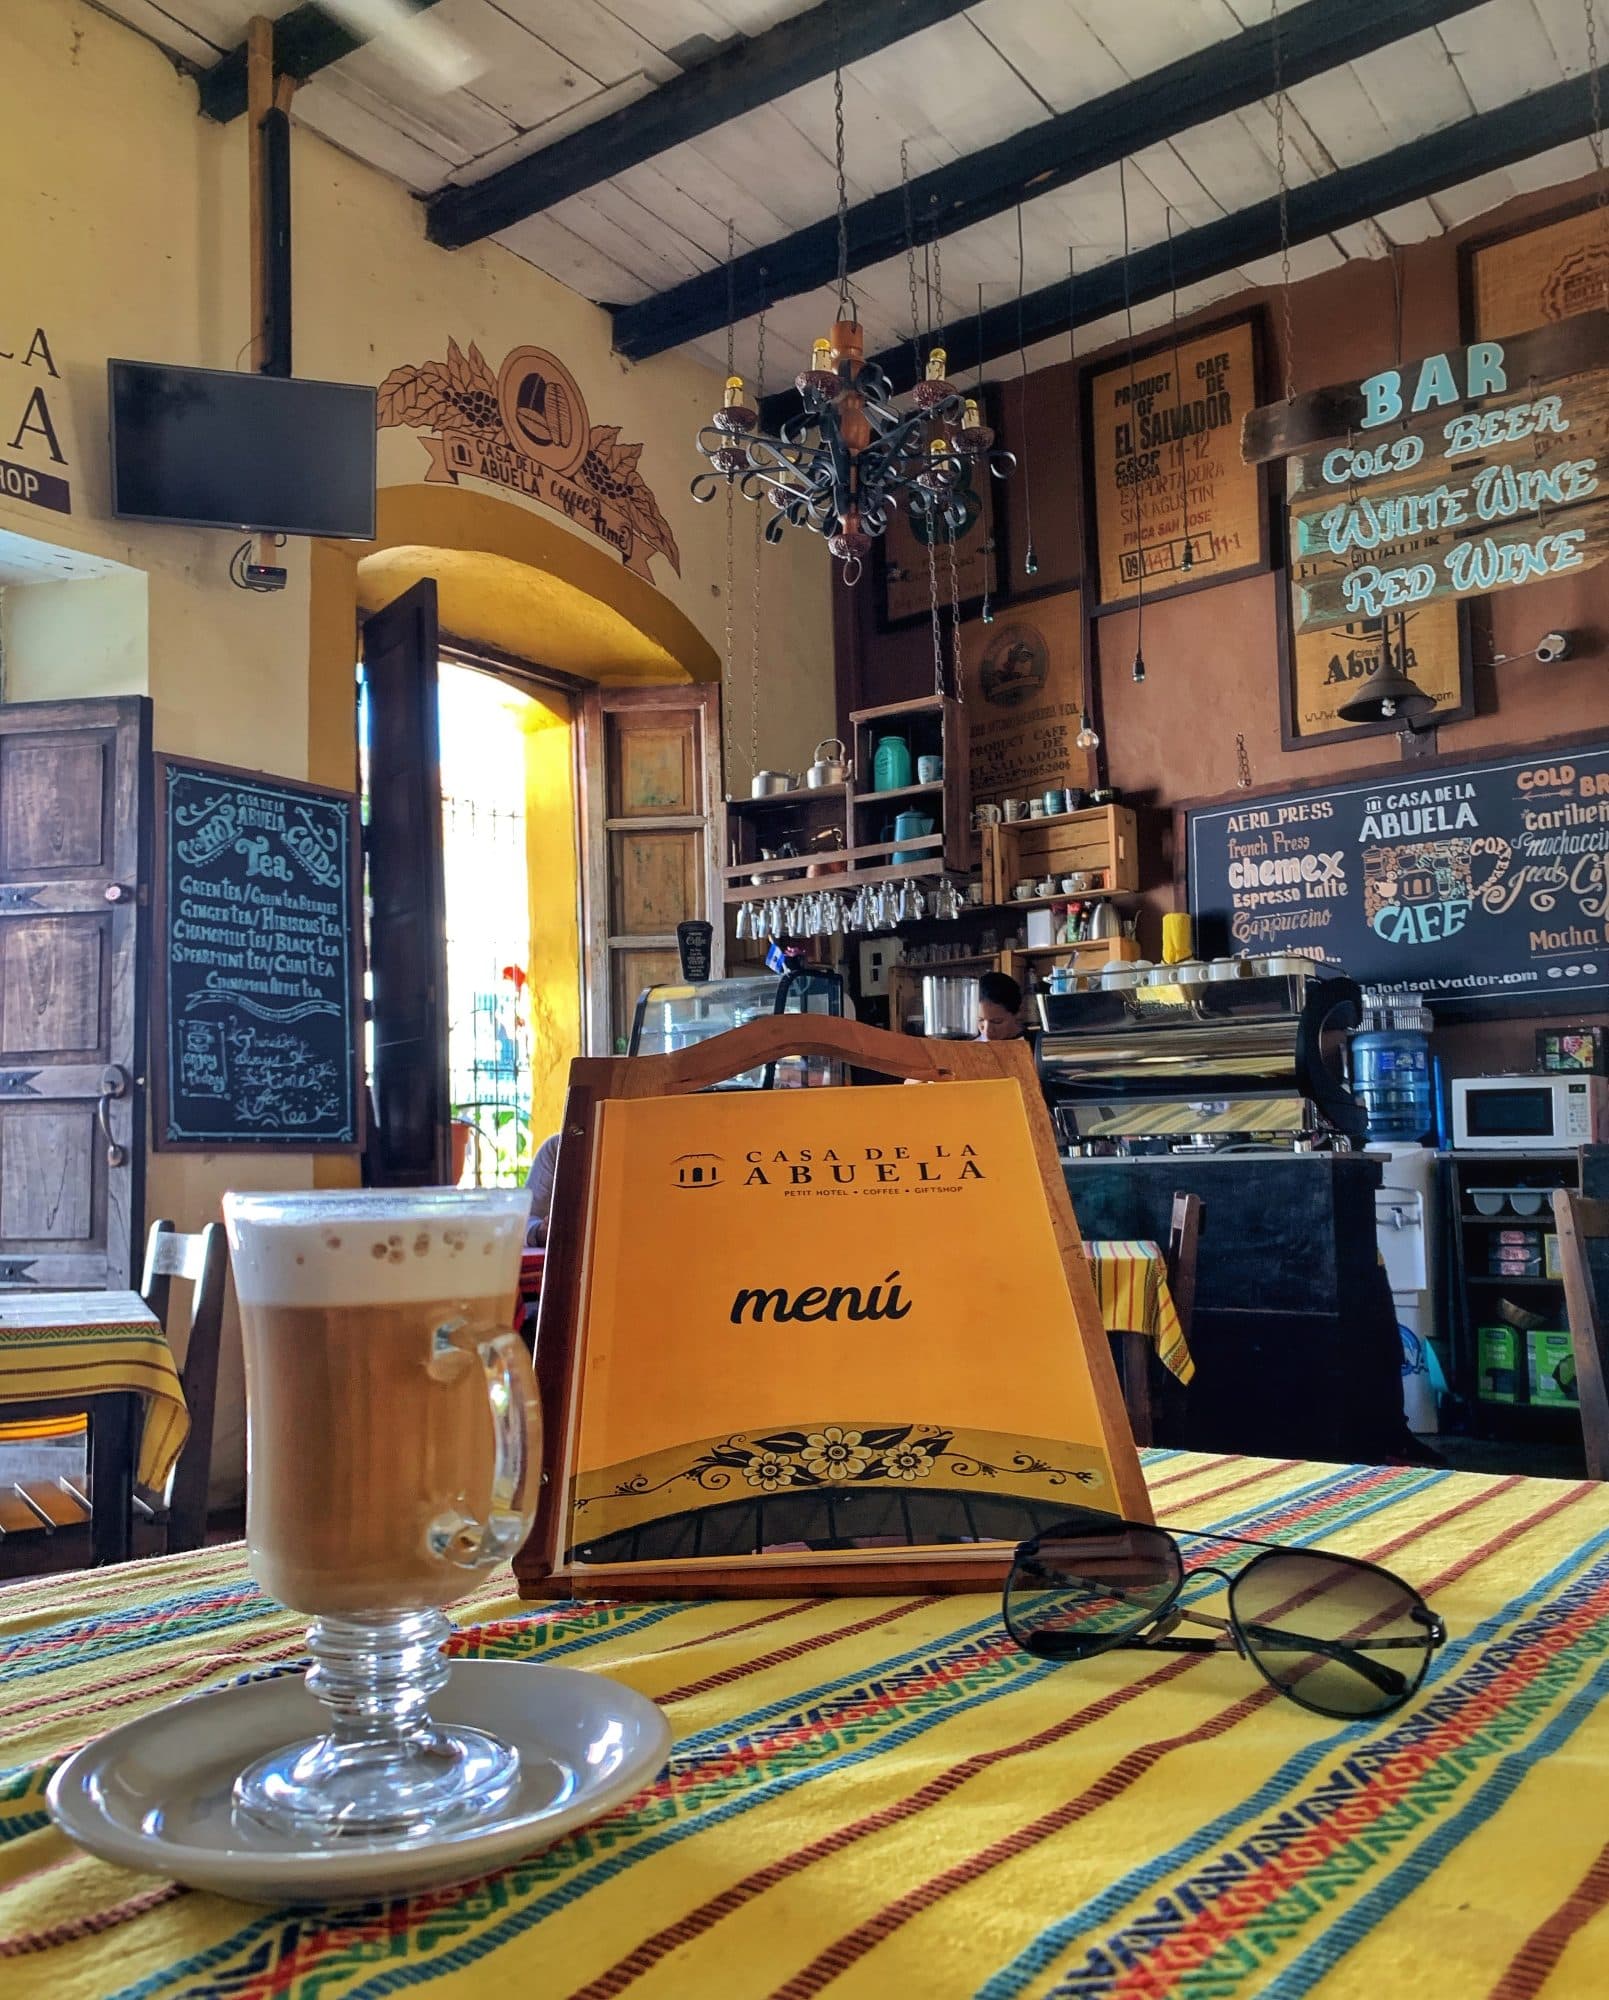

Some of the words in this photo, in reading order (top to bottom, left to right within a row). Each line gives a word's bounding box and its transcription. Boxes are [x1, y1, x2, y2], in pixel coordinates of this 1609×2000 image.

[0, 328, 61, 378] A
[1196, 353, 1230, 379] CAFE
[1114, 373, 1171, 408] PRODUCT
[1206, 374, 1225, 395] DE
[1360, 342, 1507, 429] BAR
[1137, 397, 1155, 418] OF
[1115, 422, 1134, 459] EL
[1139, 392, 1232, 450] SALVADOR
[476, 440, 512, 468] CASA
[516, 456, 528, 473] DE
[531, 464, 544, 480] LA
[1115, 450, 1160, 476] CROP
[1168, 431, 1210, 468] 11-12
[480, 457, 541, 497] ABUELA
[1115, 466, 1161, 490] COSECHA
[1158, 518, 1180, 537] SAN
[1323, 645, 1418, 685] Abula
[1517, 765, 1575, 791] COLD
[1386, 790, 1433, 810] CASA
[1435, 786, 1453, 801] DE
[1456, 783, 1477, 799] LA
[237, 807, 287, 832] ABUELA
[1227, 811, 1270, 833] AERO
[1279, 801, 1334, 824] PRESS
[1358, 802, 1480, 843] ABUELA
[1272, 831, 1310, 854] Press
[235, 836, 293, 881] Tea
[1373, 899, 1473, 944] CAFE
[1529, 925, 1600, 951] Mocha
[746, 1149, 840, 1163] CASA
[865, 1146, 911, 1161] DE
[935, 1143, 979, 1159] LA
[743, 1160, 987, 1186] ABUELA
[784, 1189, 812, 1197] PETIT
[816, 1188, 849, 1197] HOTEL
[863, 1187, 901, 1196] COFFEE
[914, 1185, 964, 1195] GIFTSHOP
[730, 1270, 912, 1324] menú
